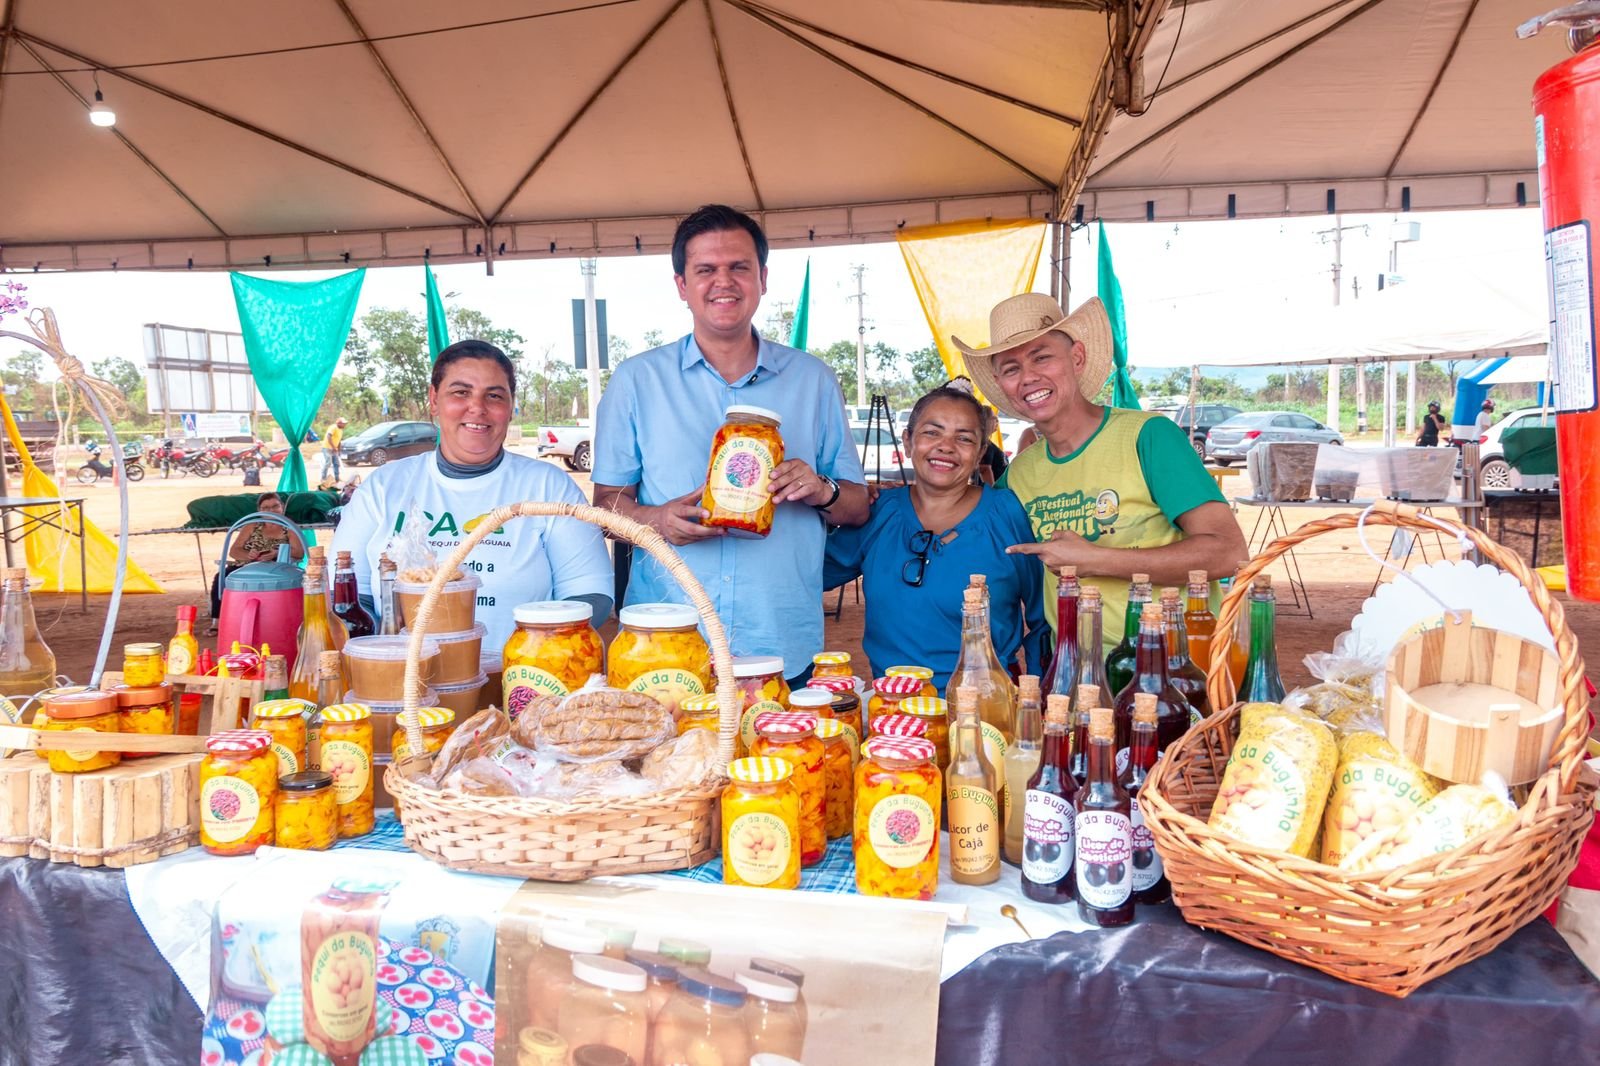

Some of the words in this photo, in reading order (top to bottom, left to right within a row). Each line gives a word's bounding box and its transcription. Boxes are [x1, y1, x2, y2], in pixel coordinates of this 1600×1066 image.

[732, 440, 744, 449] da
[749, 440, 774, 474] Buguinh
[1042, 495, 1081, 511] Festival
[1044, 506, 1085, 522] Regional
[487, 562, 495, 573] a
[651, 672, 669, 685] da
[1341, 768, 1363, 785] da
[1240, 743, 1257, 759] da
[1262, 750, 1303, 833] Buguinha
[1045, 819, 1062, 831] de
[1084, 814, 1099, 825] da
[975, 822, 989, 834] de
[958, 837, 984, 851] Cajá
[1081, 836, 1108, 851] Licor
[1109, 838, 1125, 850] de
[331, 938, 345, 952] da
